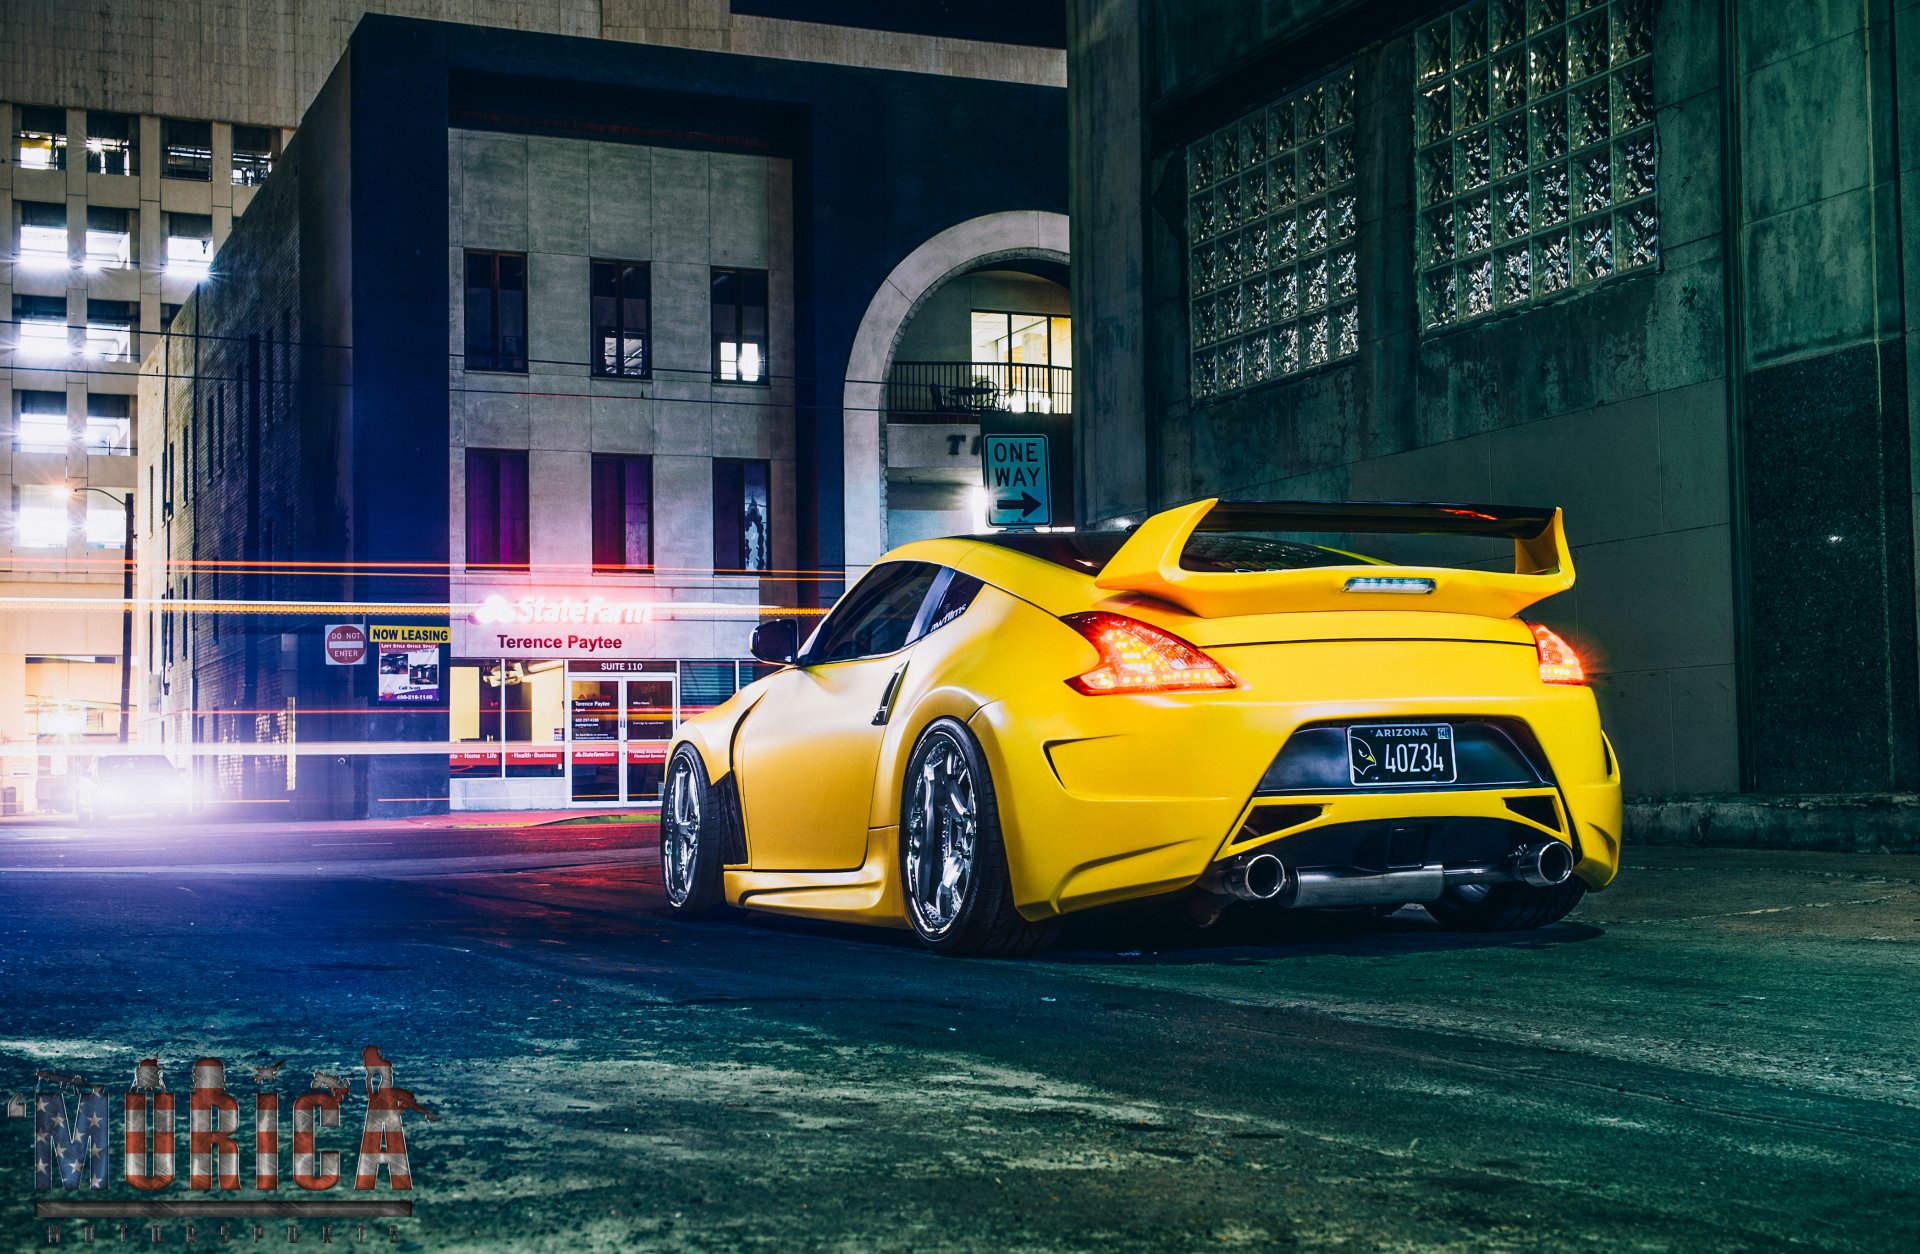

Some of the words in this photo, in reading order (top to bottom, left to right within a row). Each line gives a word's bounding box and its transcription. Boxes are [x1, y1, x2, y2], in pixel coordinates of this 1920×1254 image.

[993, 442, 1038, 463] ONE
[994, 467, 1040, 487] WAY
[372, 629, 398, 640] NOW
[401, 629, 448, 641] LEASING
[496, 634, 563, 649] Terence
[568, 635, 622, 652] Paytee
[601, 663, 625, 671] SUITE
[627, 663, 643, 671] 110
[1375, 728, 1428, 737] ARIZONA
